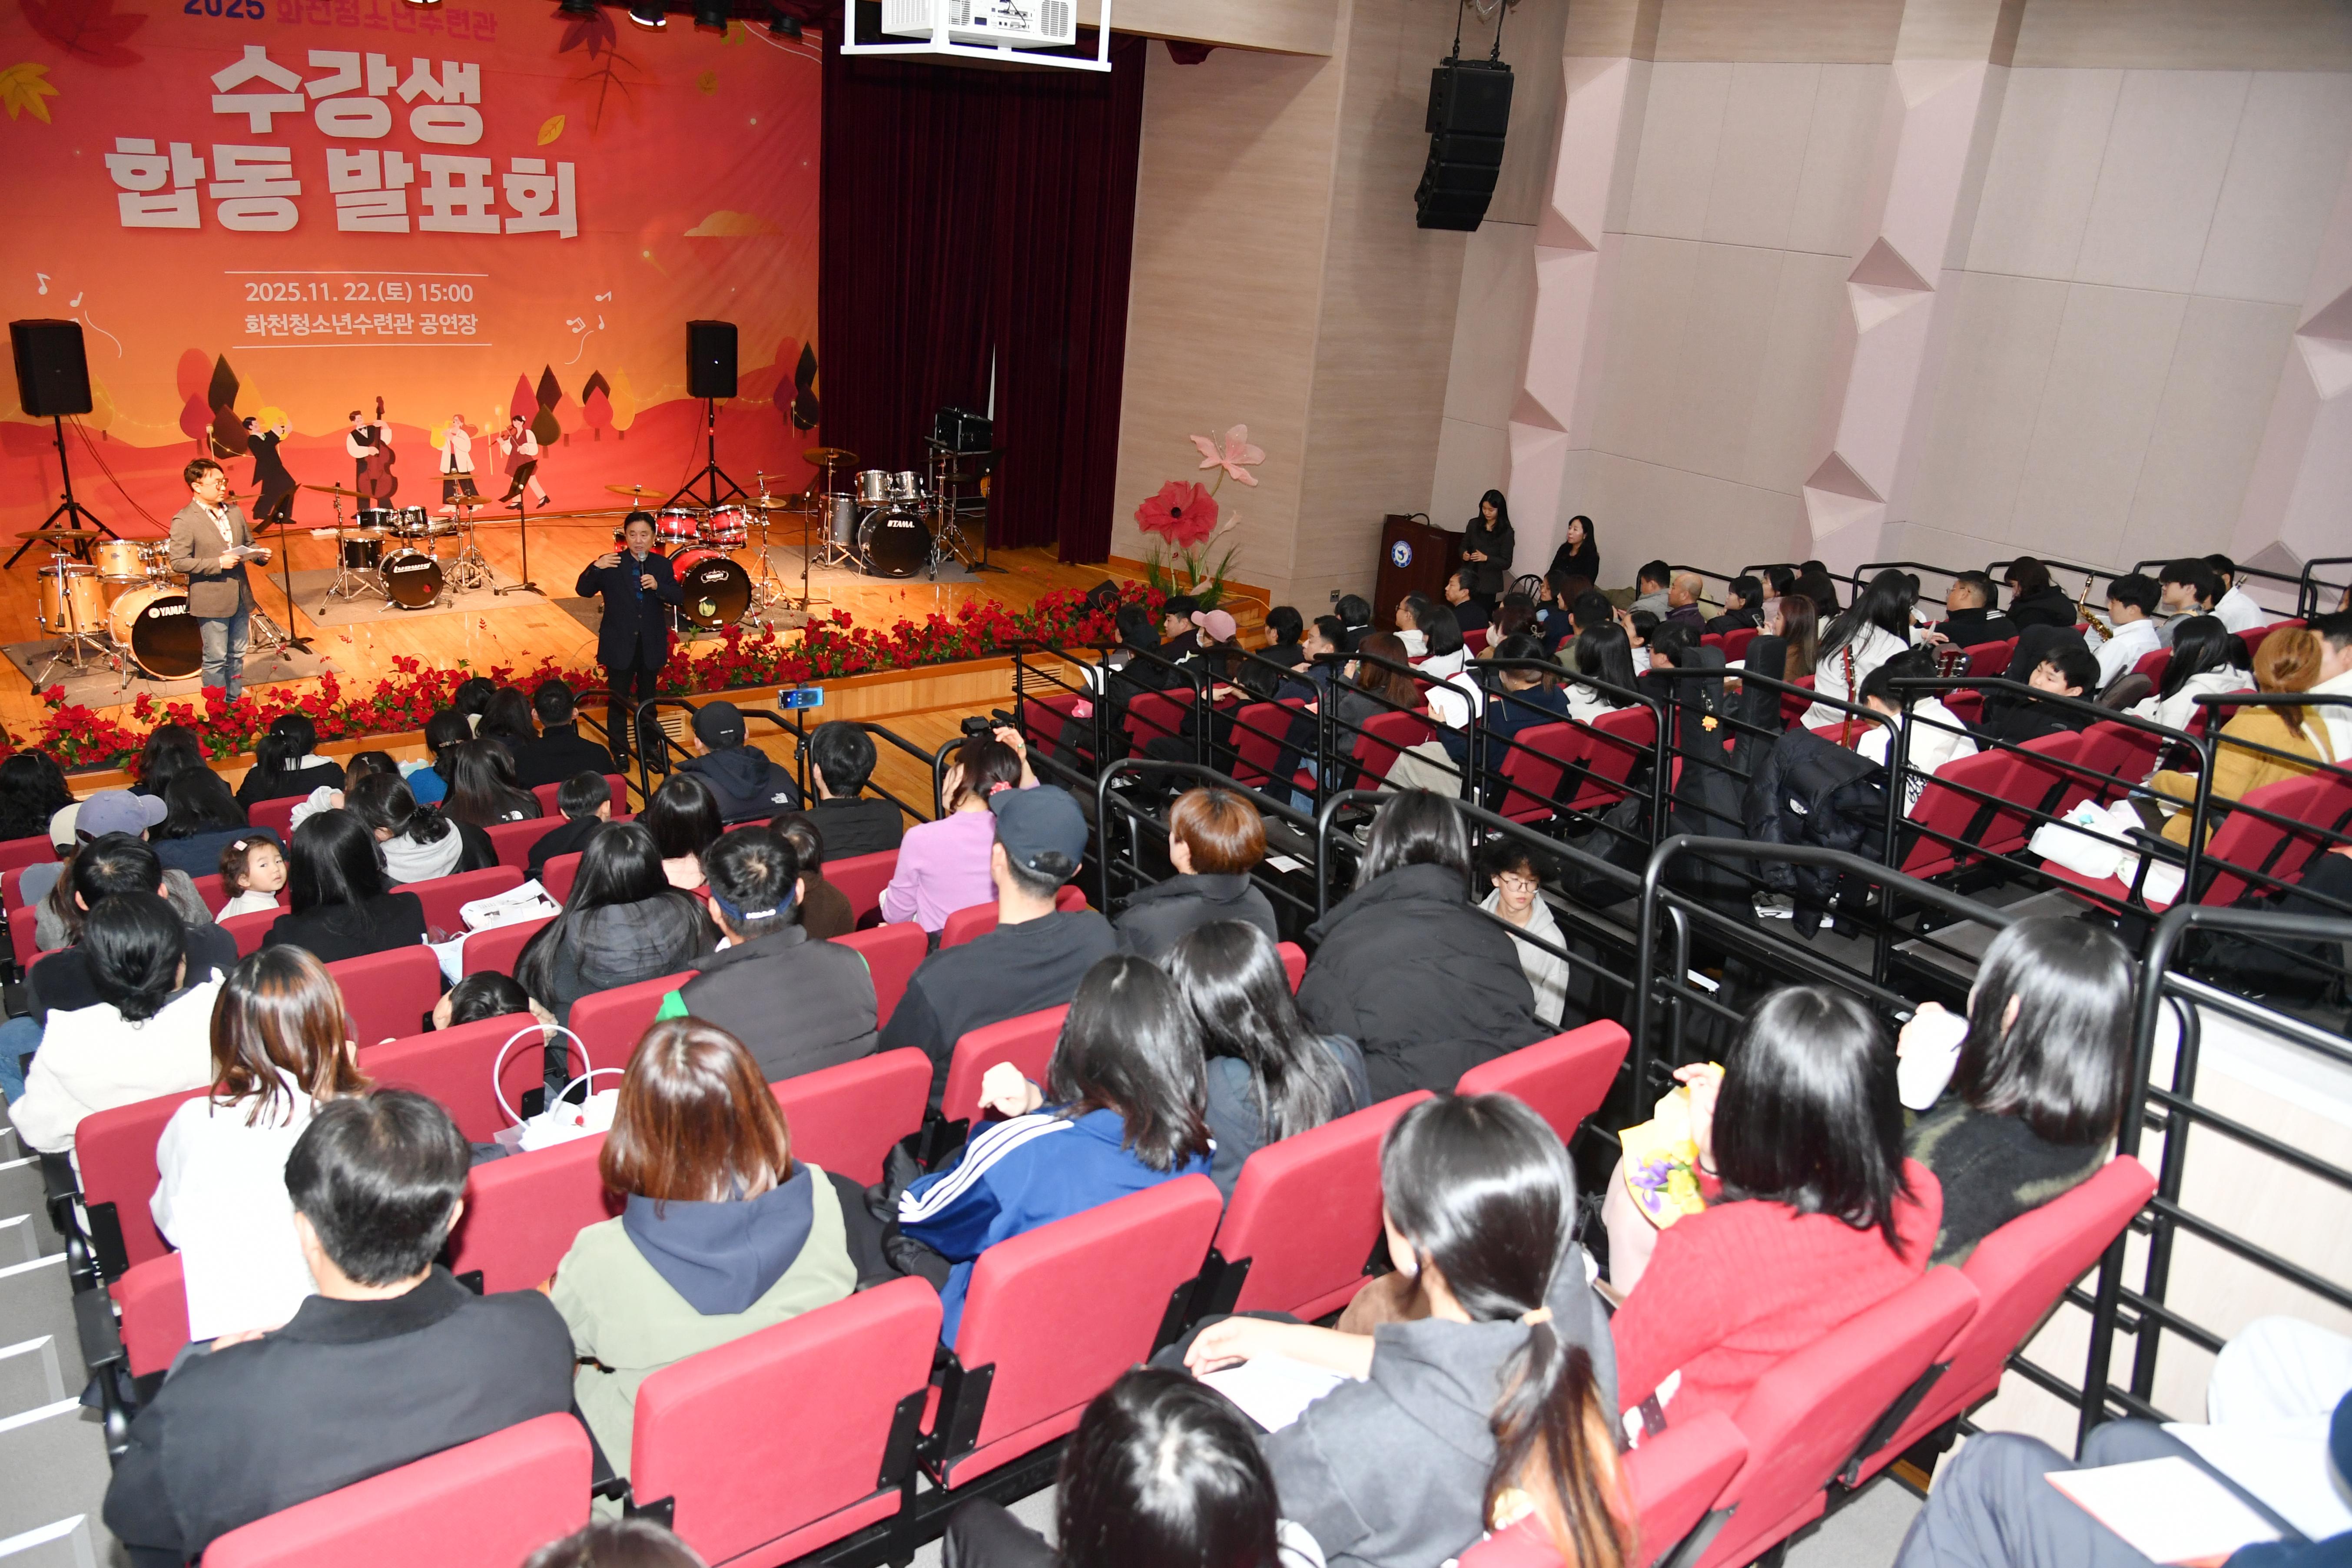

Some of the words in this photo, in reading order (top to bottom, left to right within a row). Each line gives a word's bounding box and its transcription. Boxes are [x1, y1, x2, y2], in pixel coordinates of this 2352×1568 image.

[184, 0, 265, 20] 2025
[210, 45, 483, 146] 수강생
[105, 137, 302, 232] 합동
[326, 148, 578, 239] 발표회
[245, 282, 338, 303] 2025.11.
[344, 282, 412, 303] 22.(토)
[419, 283, 474, 303] 15:00
[245, 313, 415, 337] 화천청소년수련관
[419, 314, 478, 336] 공연장
